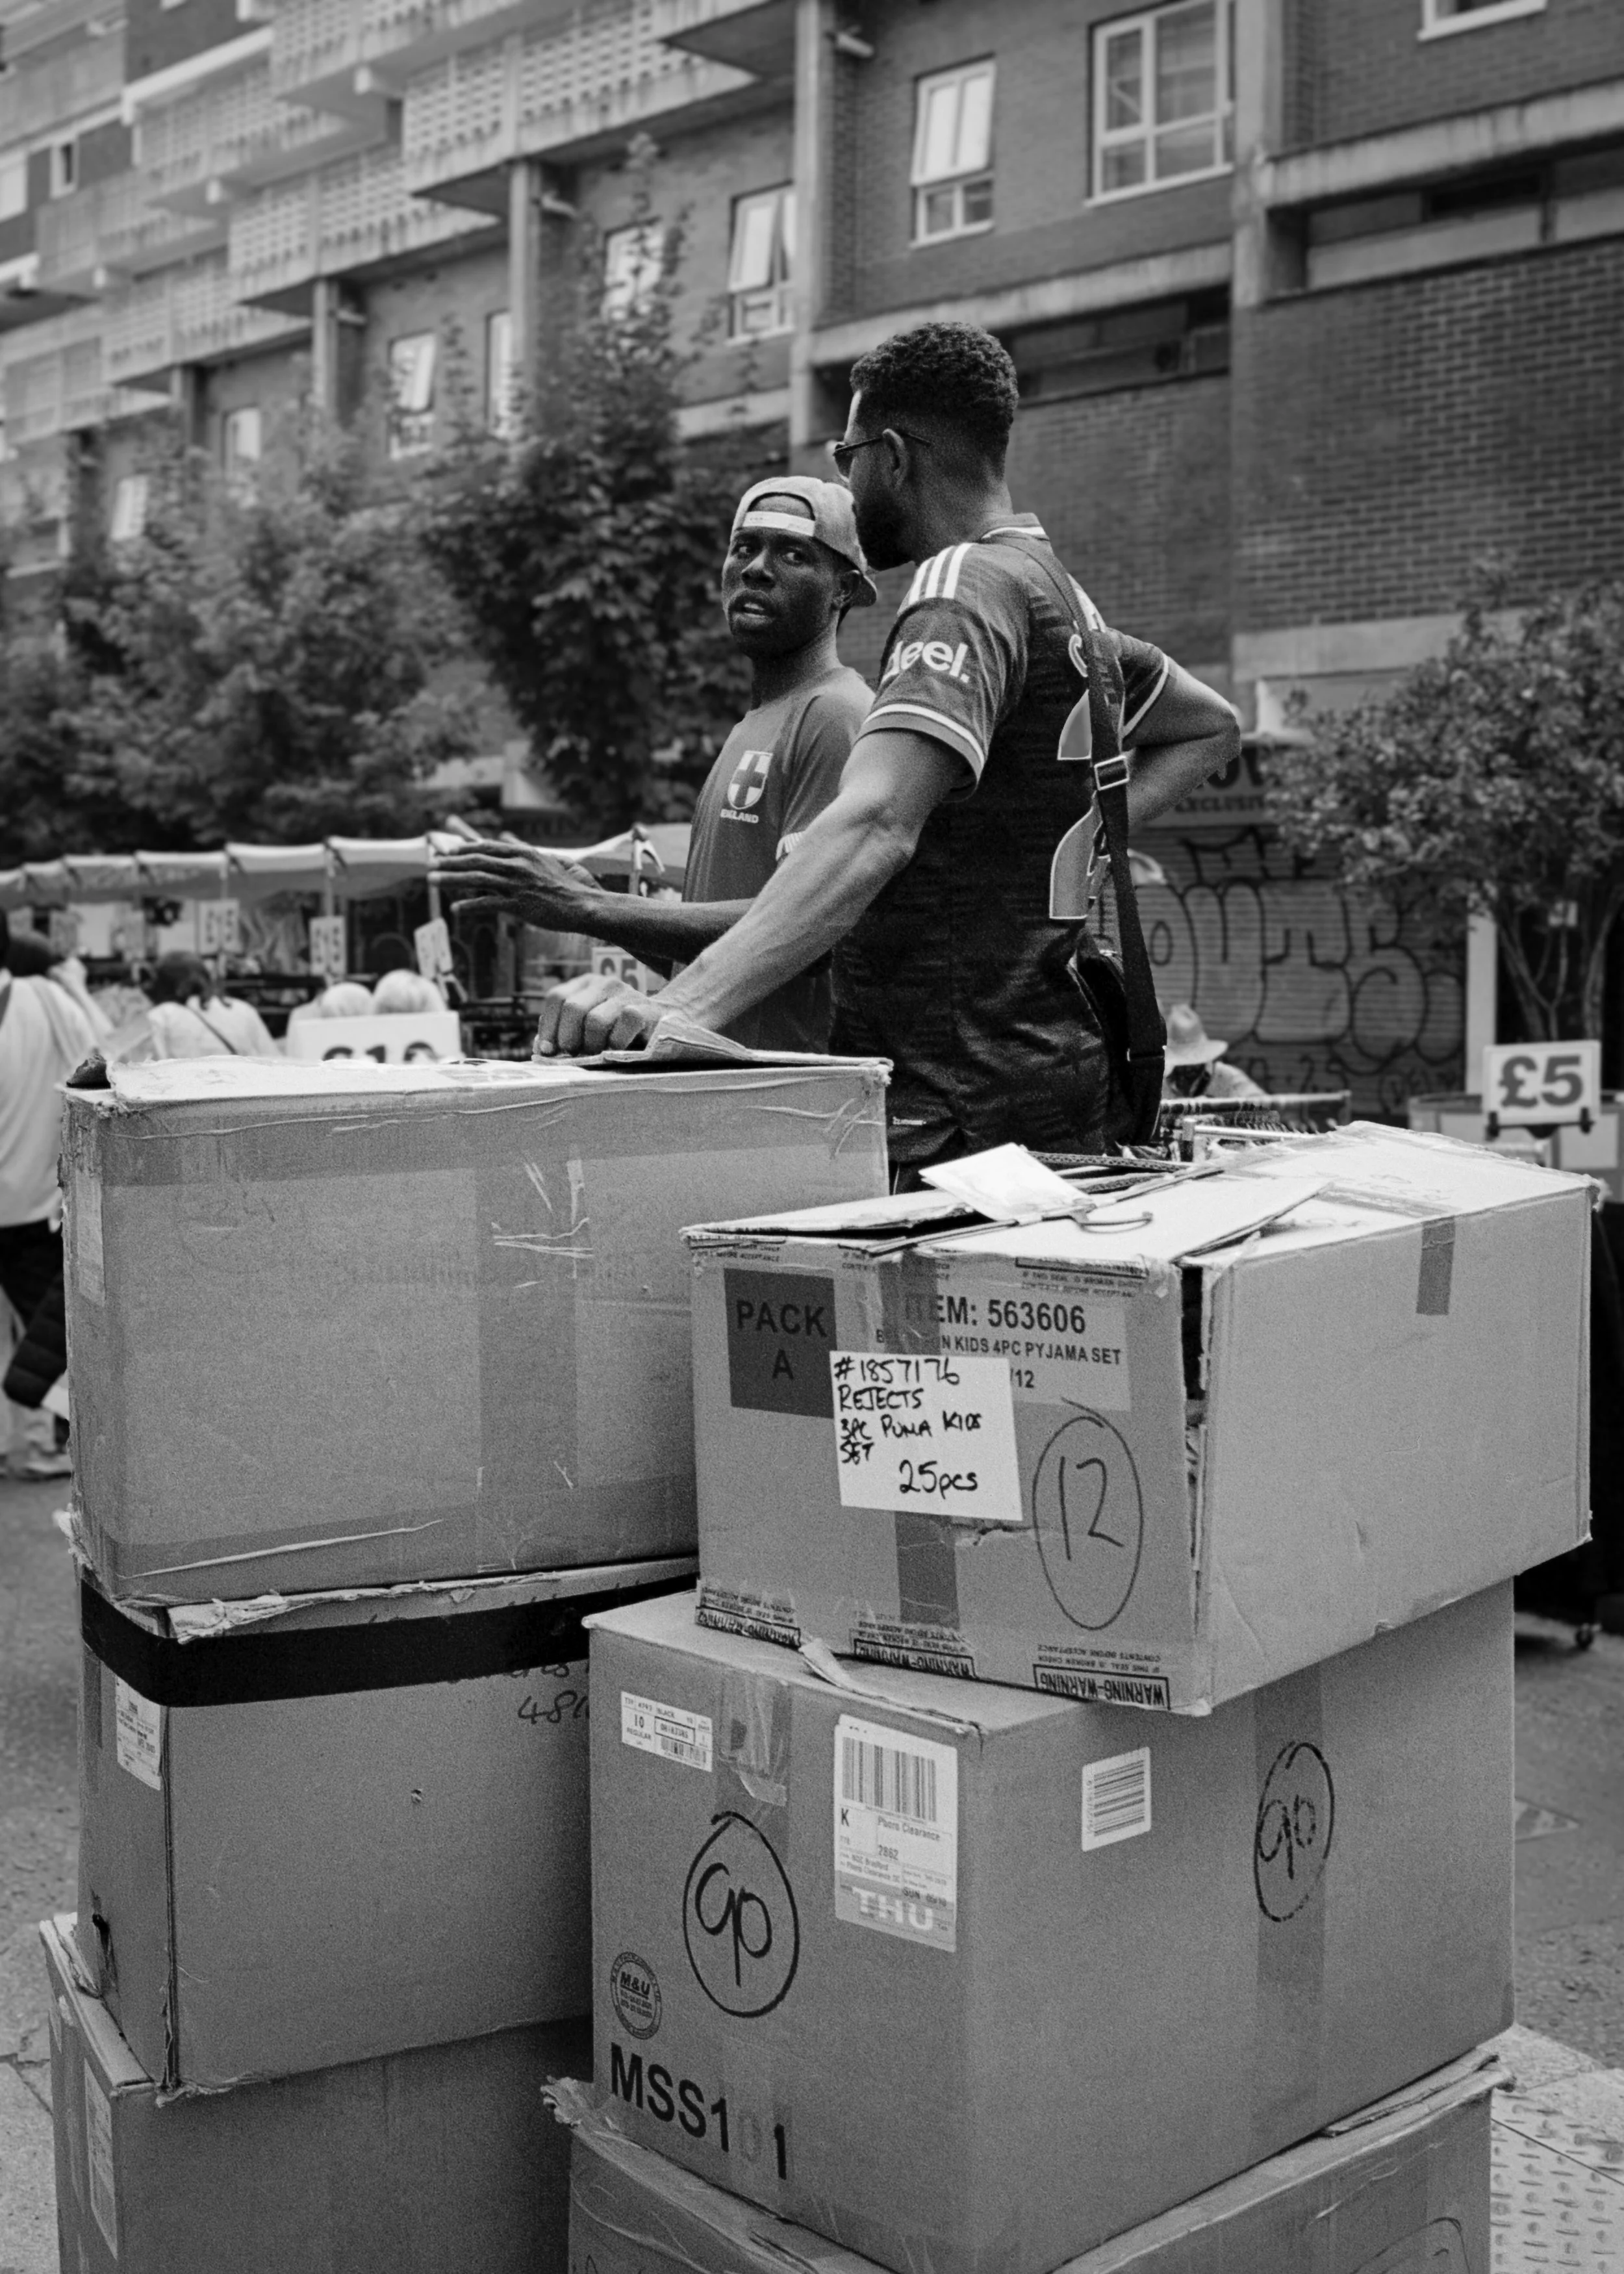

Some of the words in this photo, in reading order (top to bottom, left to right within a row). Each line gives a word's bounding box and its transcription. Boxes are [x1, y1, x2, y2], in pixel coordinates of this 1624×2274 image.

[1499, 1054, 1584, 1109] £5
[736, 1300, 828, 1338] PACK
[988, 1299, 1086, 1334] 563606
[772, 1348, 794, 1380] A
[955, 1336, 989, 1353] KIDS
[993, 1340, 1021, 1356] 4PC
[1024, 1342, 1089, 1362] PYJAMA
[1091, 1347, 1121, 1365] SET
[834, 1356, 960, 1385] #1857176
[837, 1384, 924, 1412] REJECTS
[841, 1418, 872, 1440] 3PC
[880, 1413, 933, 1438] PUMA
[898, 1459, 978, 1500] 25pcs
[1058, 1455, 1124, 1561] 12
[634, 1713, 645, 1729] 10
[841, 1808, 850, 1828] K
[902, 1822, 941, 1841] Clearance
